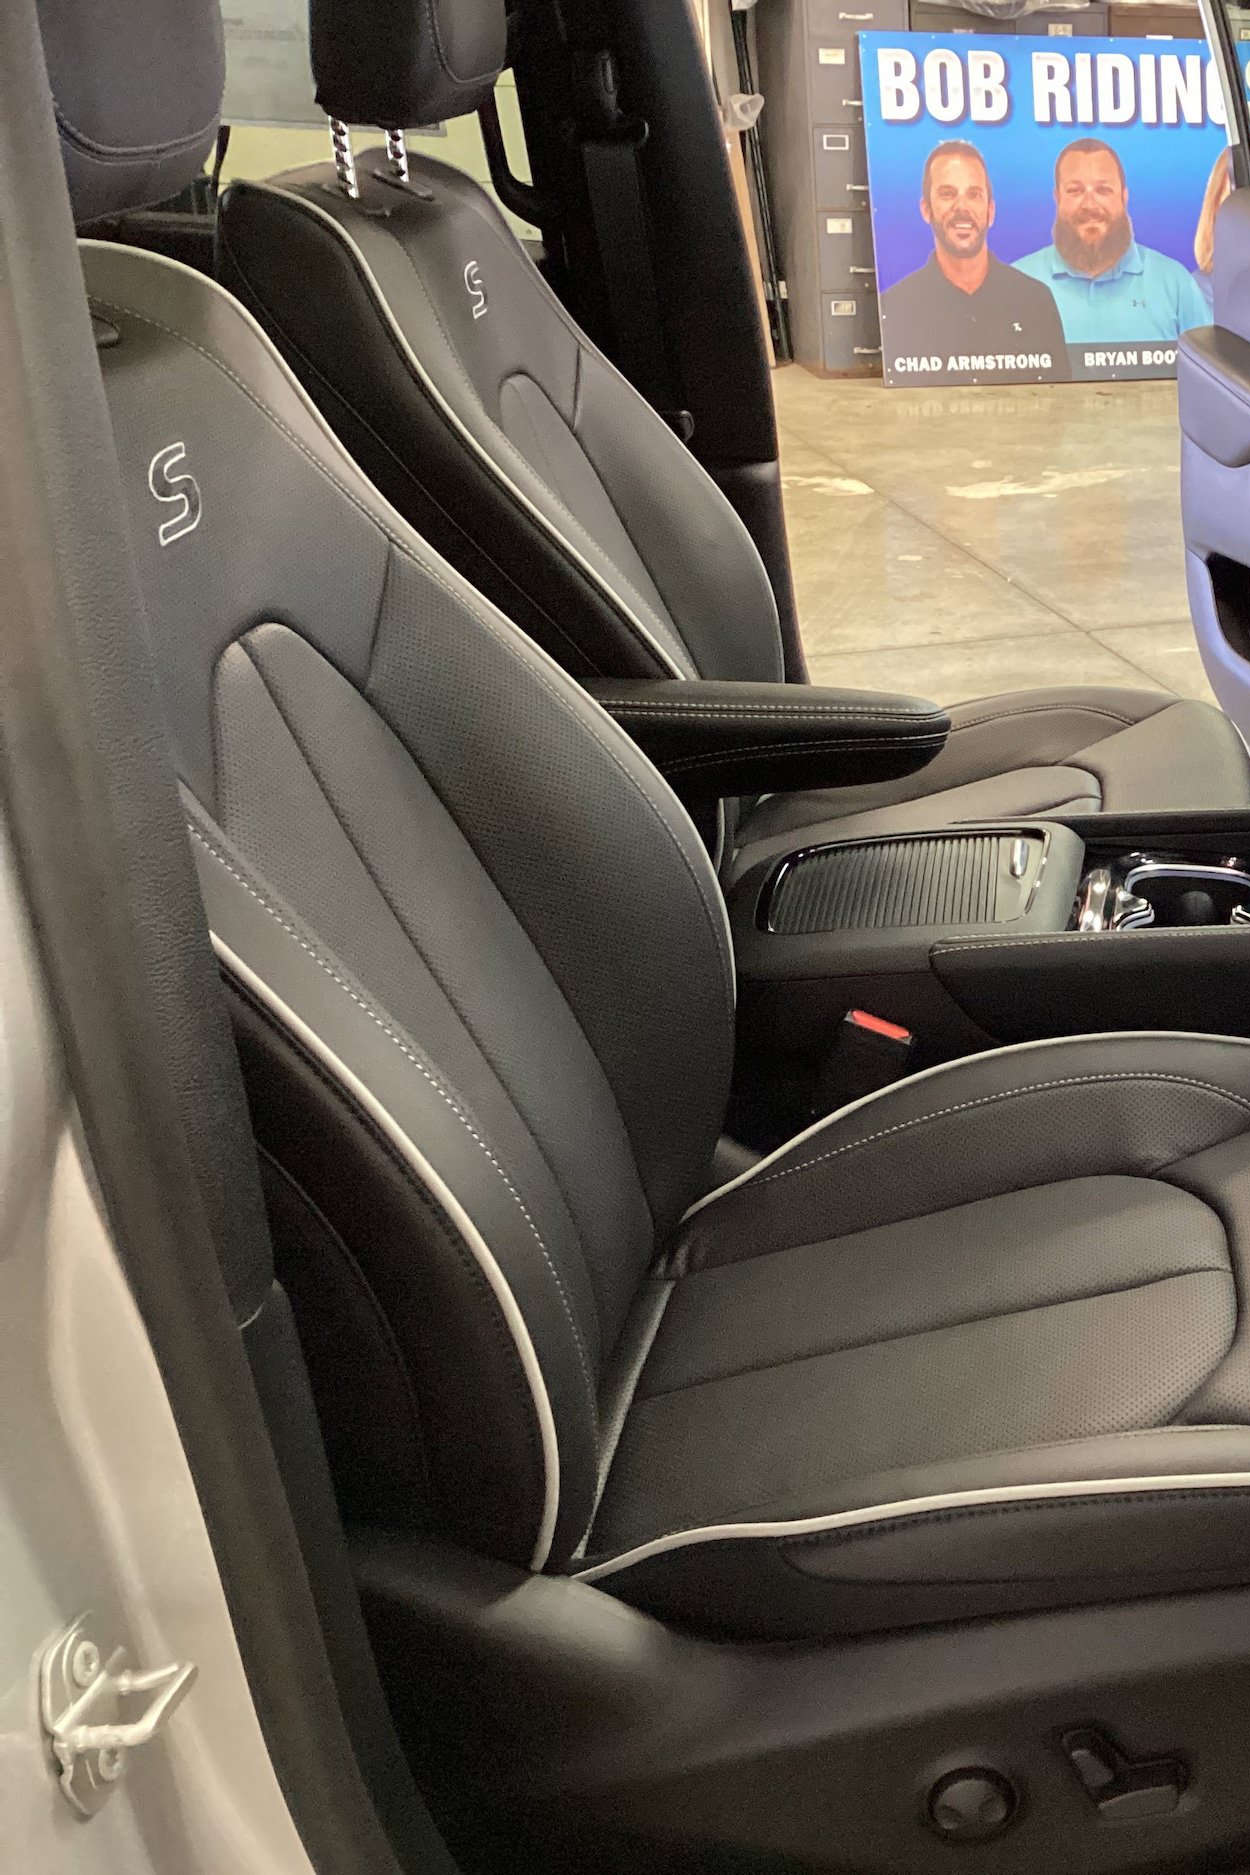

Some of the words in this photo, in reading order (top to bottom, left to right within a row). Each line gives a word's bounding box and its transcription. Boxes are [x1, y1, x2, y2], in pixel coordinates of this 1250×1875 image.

[876, 48, 1009, 122] BOB
[464, 260, 488, 319] S
[895, 356, 943, 373] CHAD
[947, 353, 1052, 371] ARMSTRONG
[1084, 351, 1138, 366] BRYAN
[1142, 350, 1178, 365] BOO
[148, 441, 202, 547] S
